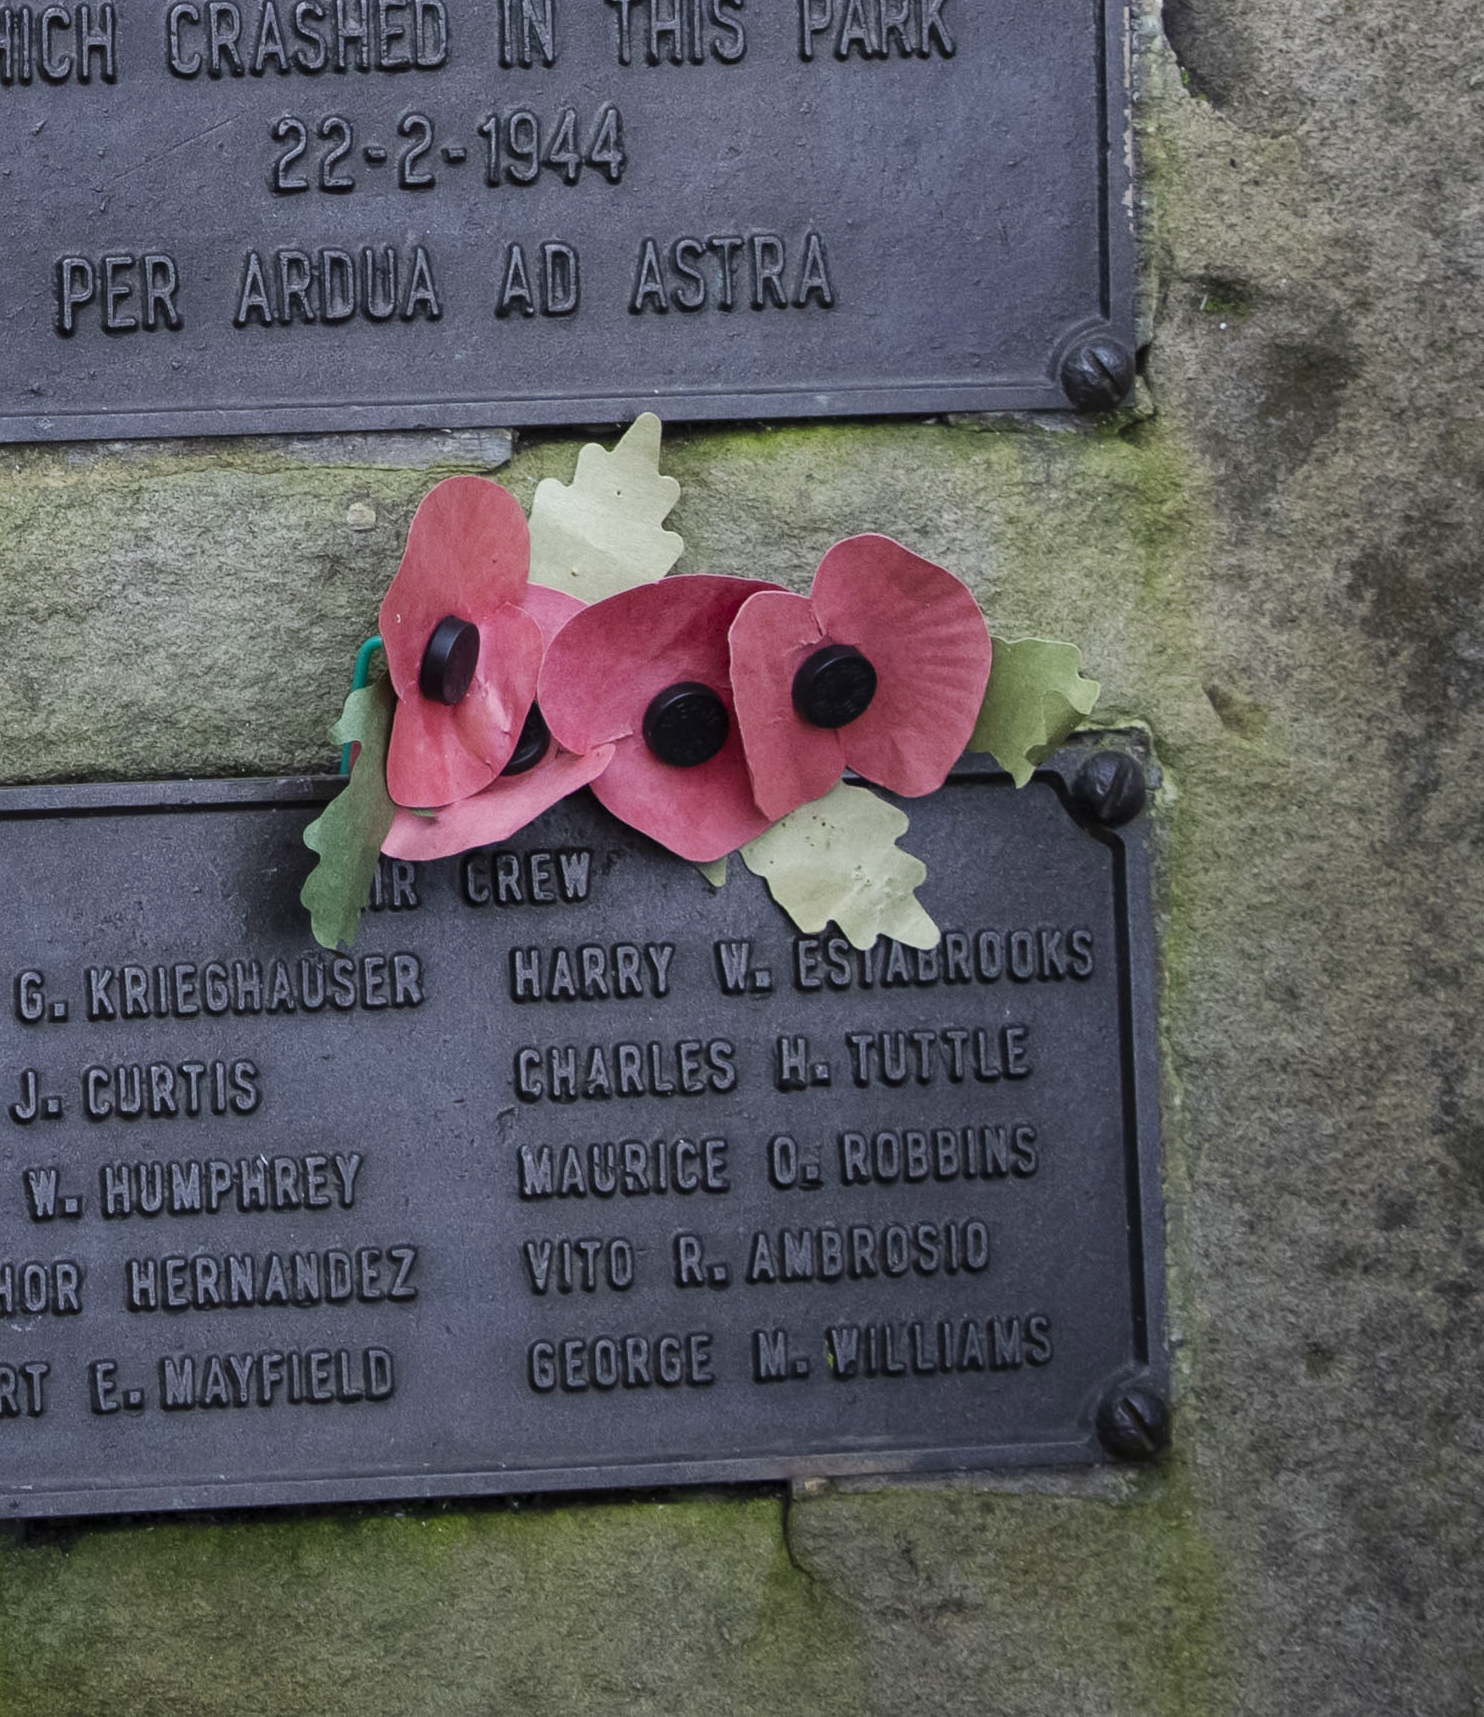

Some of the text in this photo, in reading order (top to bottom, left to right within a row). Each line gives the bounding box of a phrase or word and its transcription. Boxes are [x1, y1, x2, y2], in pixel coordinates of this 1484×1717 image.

[272, 102, 624, 192] 22-2-1944
[56, 234, 834, 337] PER ARDUA AD ASTRA
[362, 852, 592, 910] IR CREW
[19, 970, 68, 1022] G.
[87, 954, 423, 1021] KRIEGHAUSER
[511, 943, 673, 1002] HARRY
[717, 940, 771, 993] W.
[13, 1069, 60, 1120] J.
[85, 1061, 260, 1120] CURTIS
[517, 1026, 1030, 1101] CHARLES H. TUTTLE
[28, 1168, 80, 1220] W.
[104, 1154, 361, 1217] HUMPHREY
[519, 1125, 1037, 1197] MAURICE O. ROBBINS
[129, 1247, 416, 1311] HERNANDEZ
[527, 1221, 989, 1293] VITO R. AMBROSIO
[90, 1362, 143, 1413] E.
[161, 1348, 393, 1409] MAYFIELD
[530, 1316, 1052, 1390] GEORGE M. WILLIAMS
